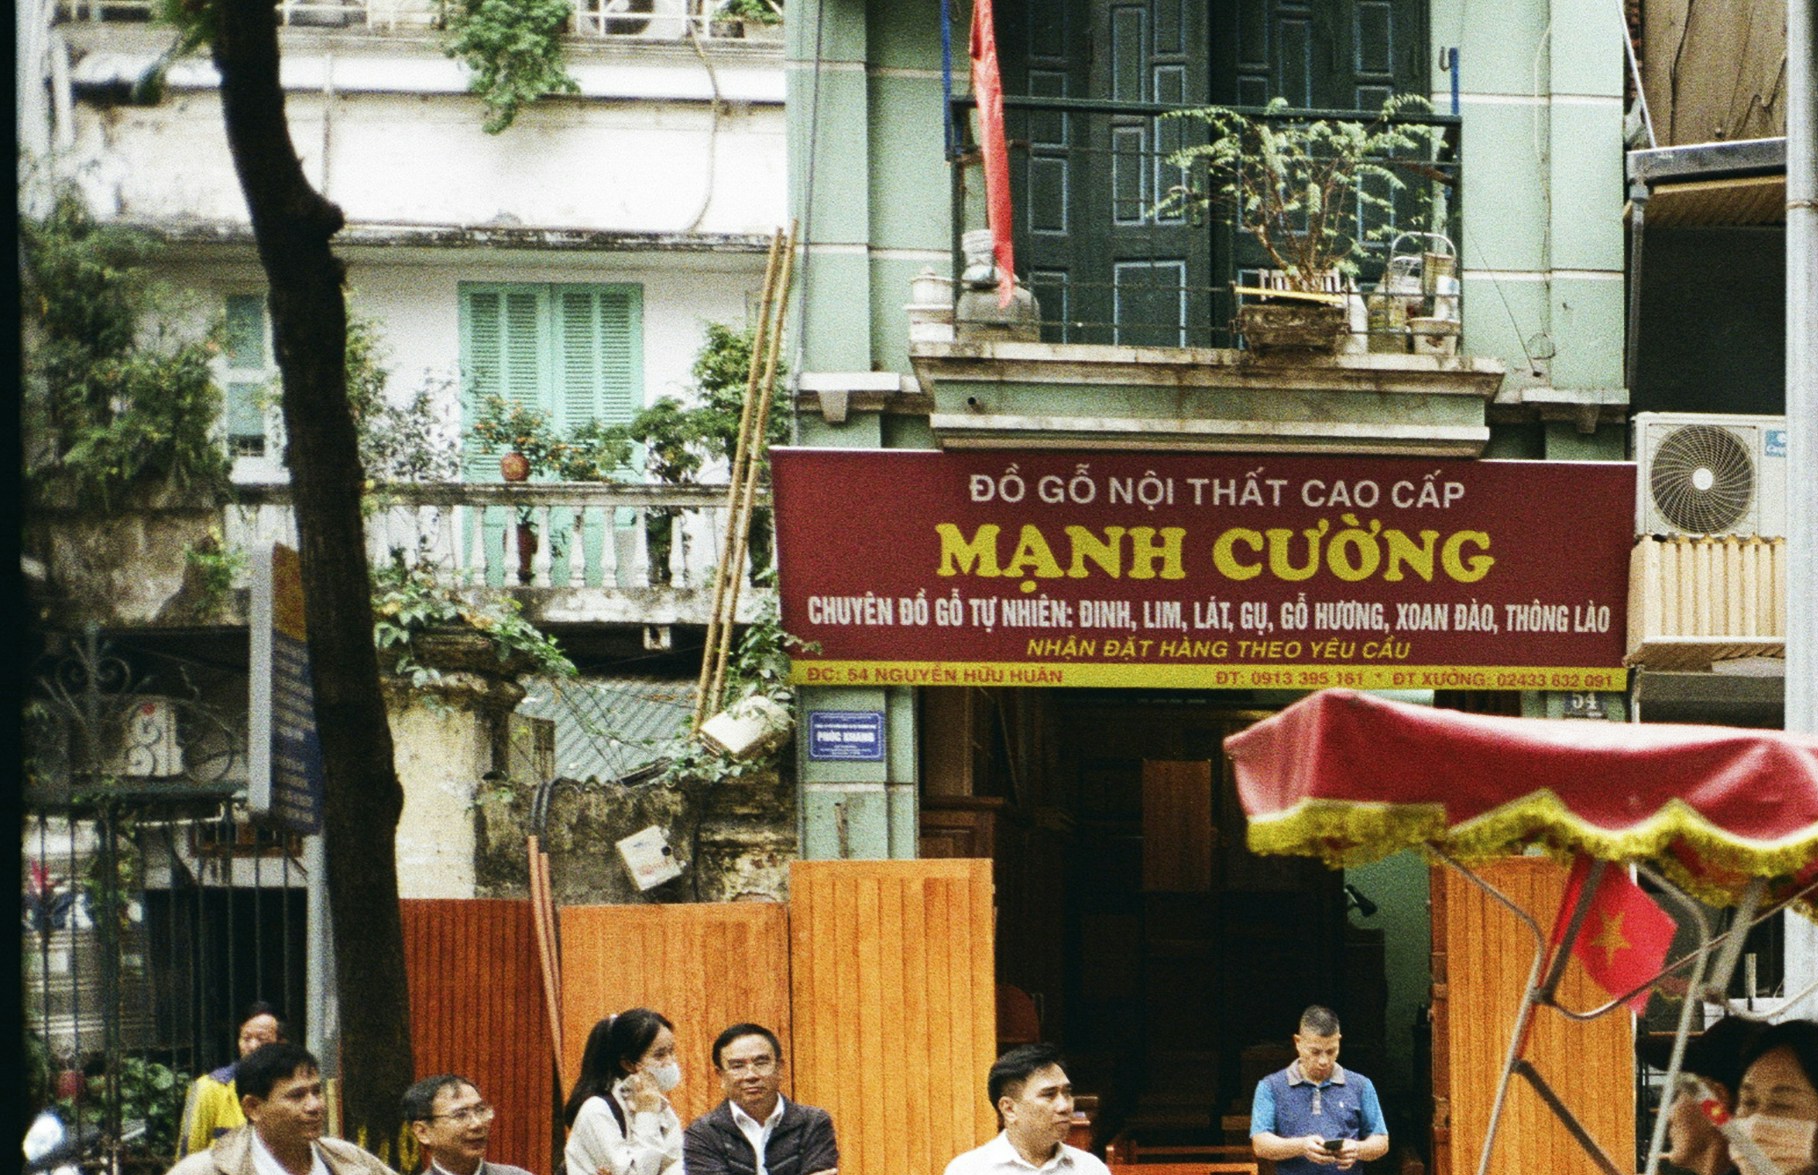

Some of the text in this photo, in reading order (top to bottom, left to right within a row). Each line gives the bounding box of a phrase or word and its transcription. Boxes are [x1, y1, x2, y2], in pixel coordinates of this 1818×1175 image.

[970, 463, 1466, 511] ĐỒ GỖ NỘI THẤT CAO CẤP
[934, 512, 1496, 593] MẠNH CƯỜNG
[807, 588, 1611, 636] CHUYÊN ĐỒ GỖ TỰ NHIÊN: ĐINH, LIM, LÁT, GỤ, GỖ HƯƠNG, XOAN ĐÀO, THÔNG LÀO
[1027, 635, 1411, 661] NHẬN ĐẶT HÀNG THEO YÊU CẦU
[847, 668, 868, 682] 54
[1215, 670, 1244, 685] ĐT:
[1251, 671, 1293, 685] 0913
[1298, 671, 1329, 685] 395
[1393, 672, 1415, 686] ĐT
